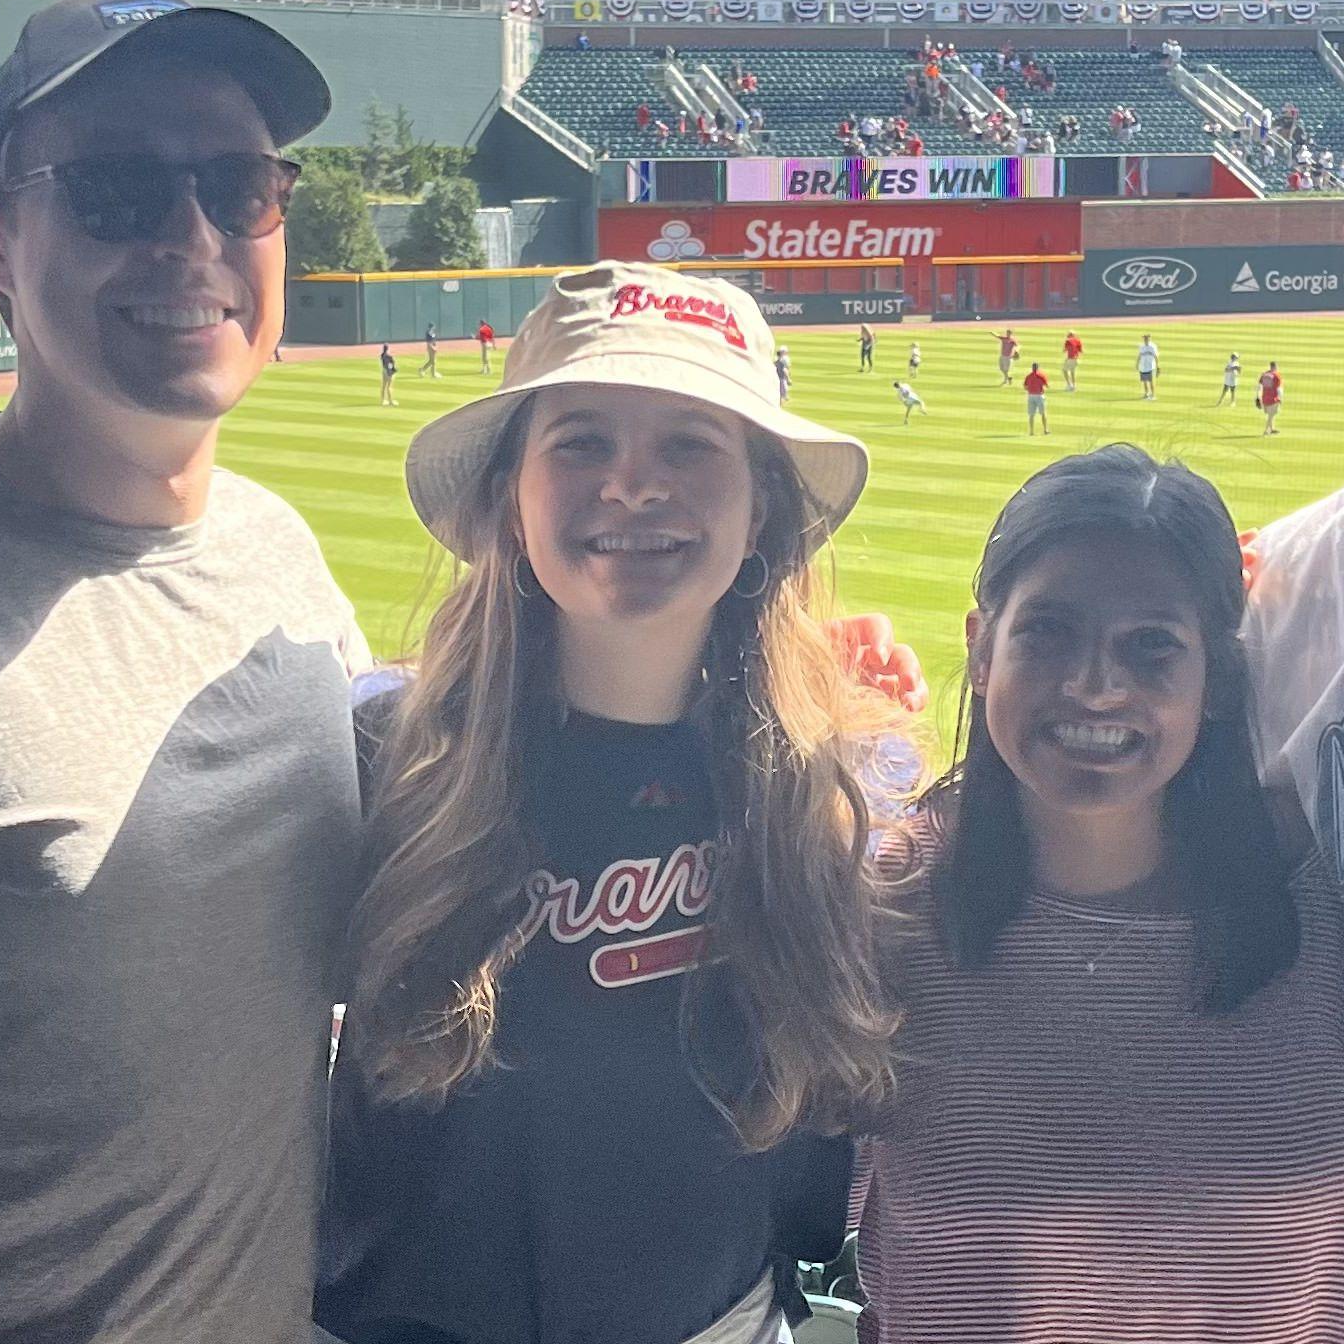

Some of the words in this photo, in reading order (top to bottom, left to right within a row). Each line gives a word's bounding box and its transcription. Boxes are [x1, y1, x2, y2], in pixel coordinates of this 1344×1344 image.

[788, 168, 917, 197] BRAVES
[928, 167, 997, 194] WIN
[1119, 261, 1181, 290] Ford
[1264, 269, 1339, 295] Georgia
[609, 283, 726, 320] Braves
[759, 302, 804, 316] TWORK
[840, 298, 904, 316] TRUIST
